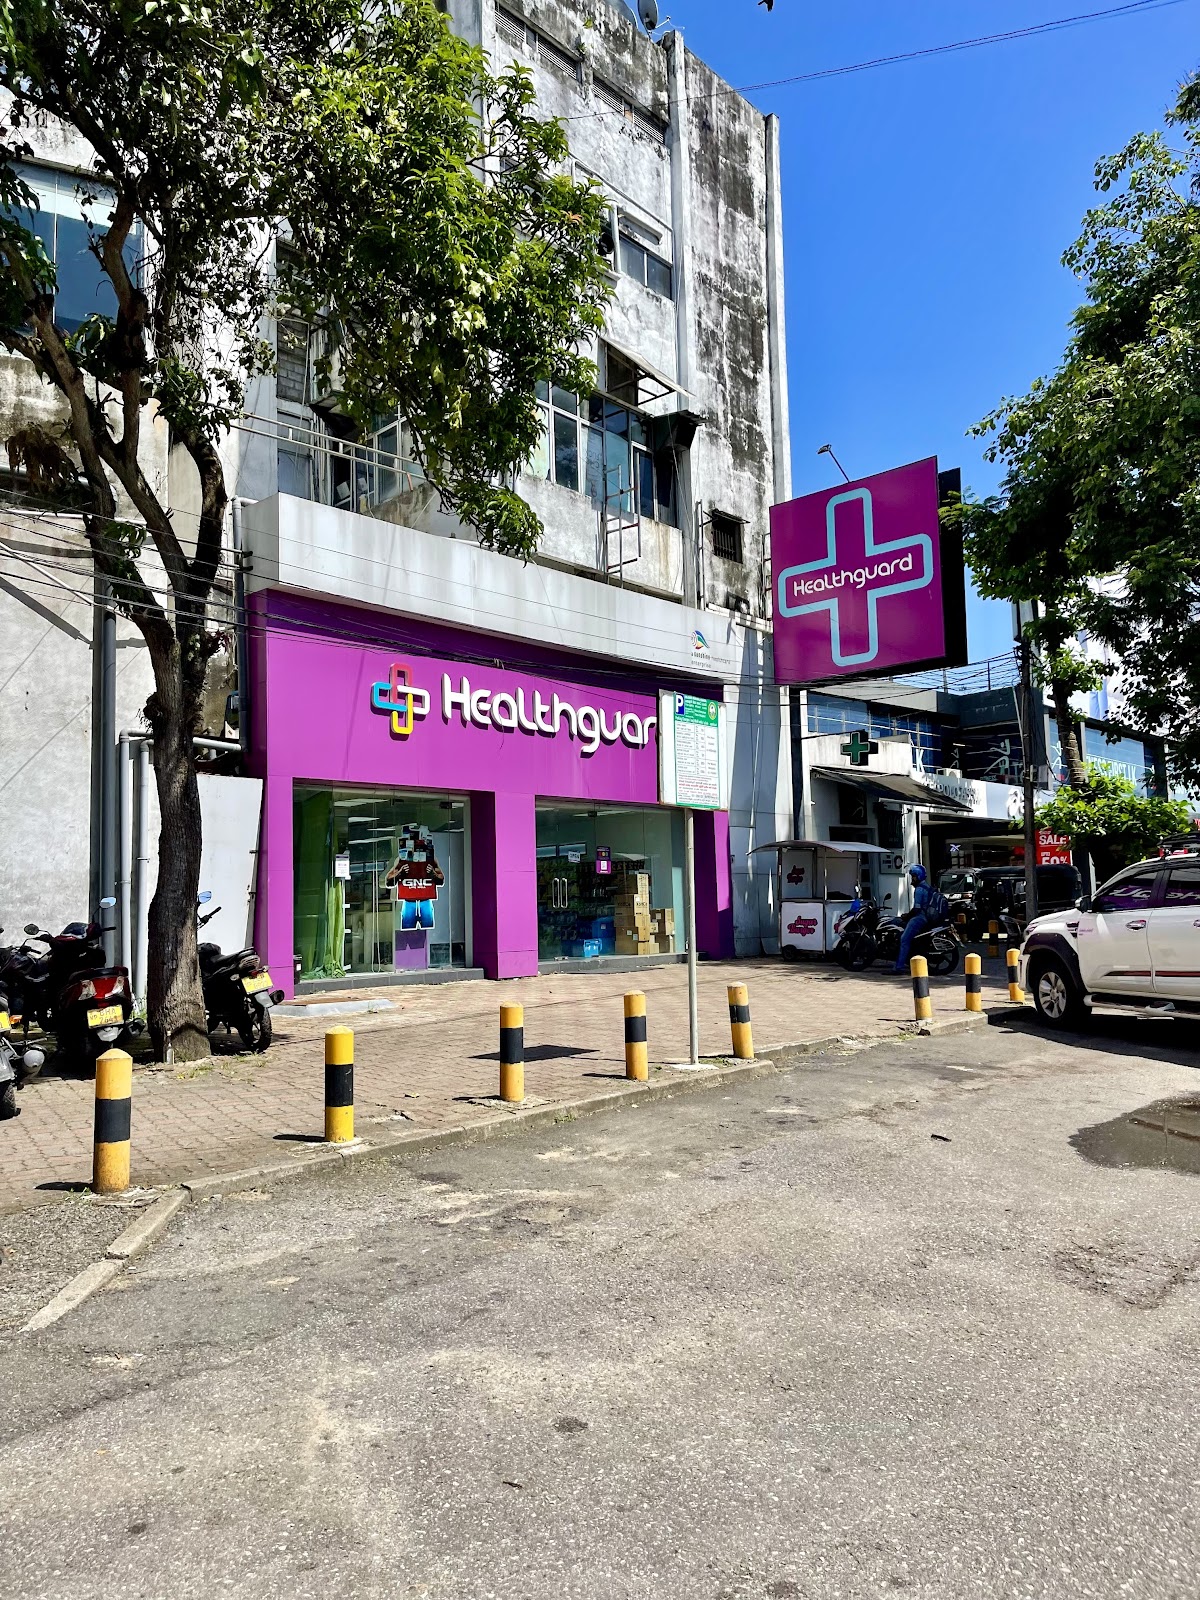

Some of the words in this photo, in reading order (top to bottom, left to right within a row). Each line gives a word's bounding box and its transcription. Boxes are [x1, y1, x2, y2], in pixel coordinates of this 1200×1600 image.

[793, 553, 913, 597] Healthguard
[441, 673, 656, 753] Healthguar
[1039, 834, 1067, 845] SALE
[402, 878, 432, 887] GNC
